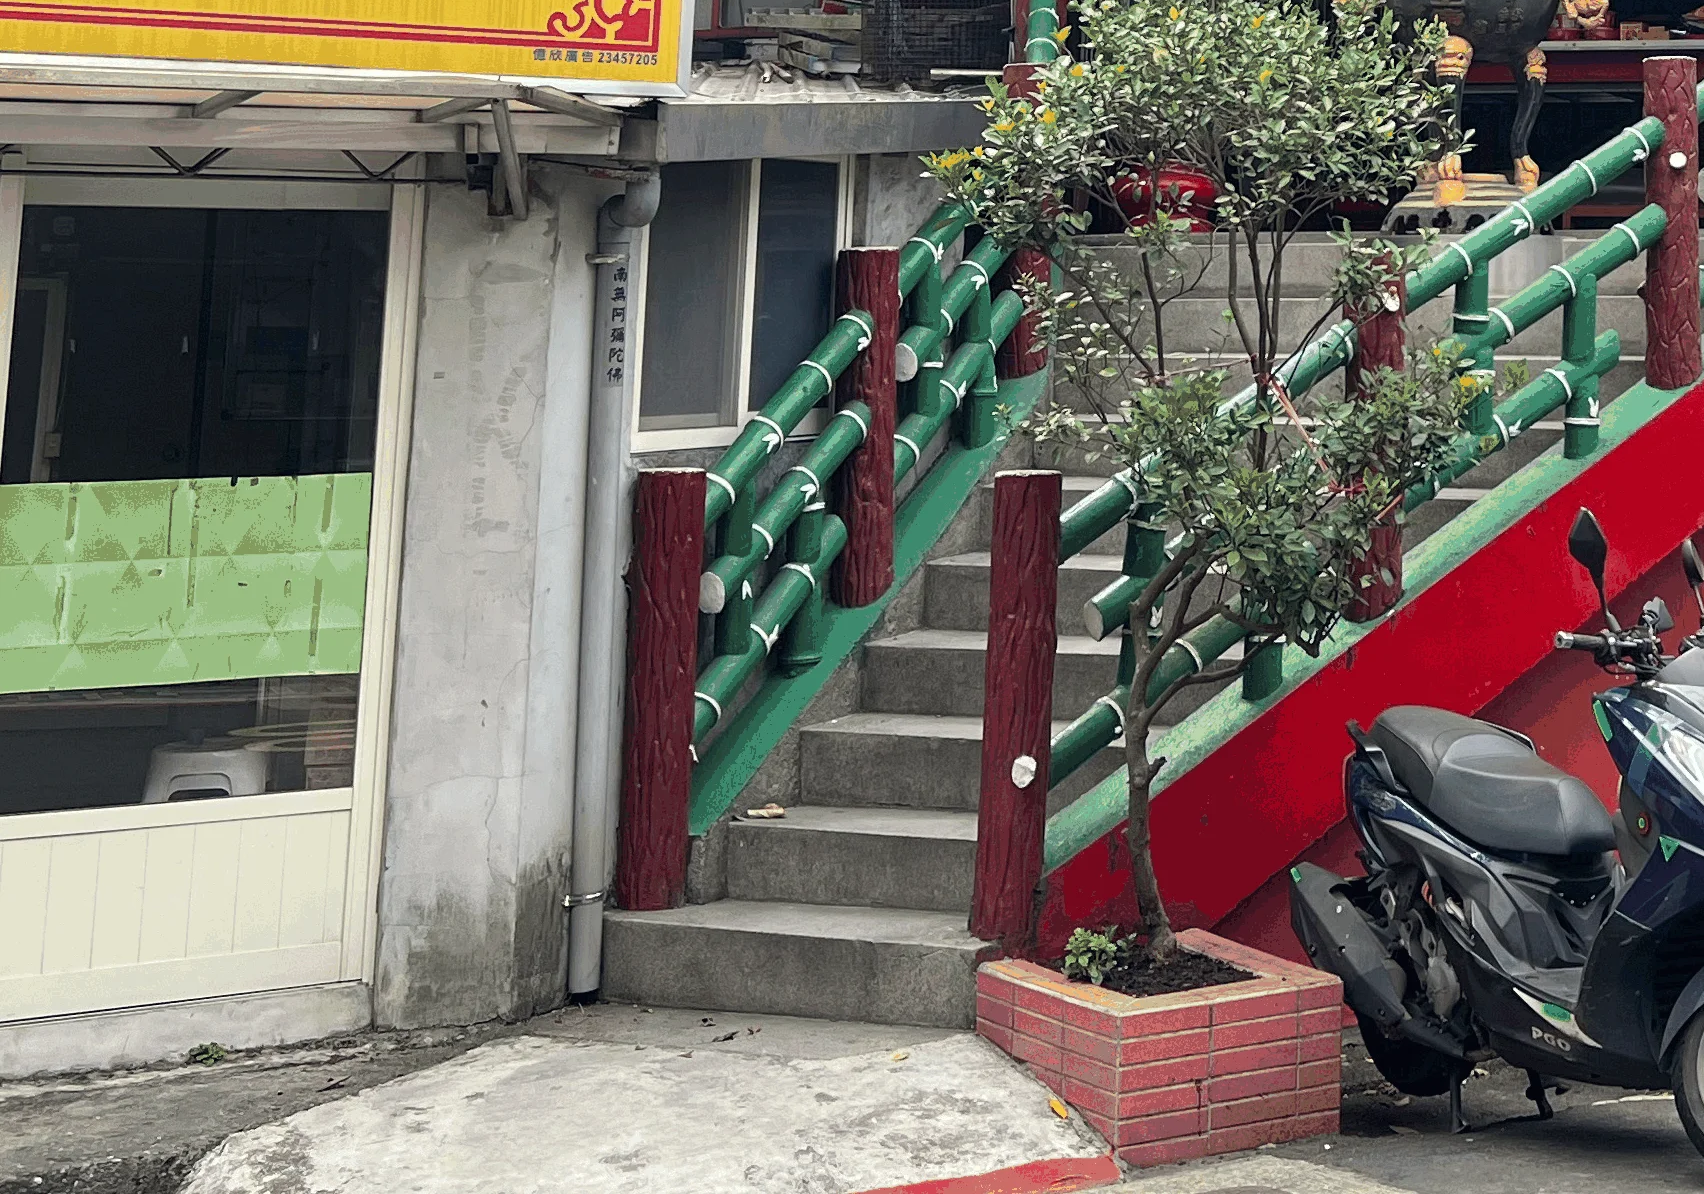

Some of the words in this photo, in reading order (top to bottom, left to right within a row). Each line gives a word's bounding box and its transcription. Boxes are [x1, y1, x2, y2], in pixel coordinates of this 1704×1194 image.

[597, 51, 658, 66] 23457205
[606, 266, 628, 384] 南無阿彌陀佛
[1531, 1026, 1572, 1052] PGO
